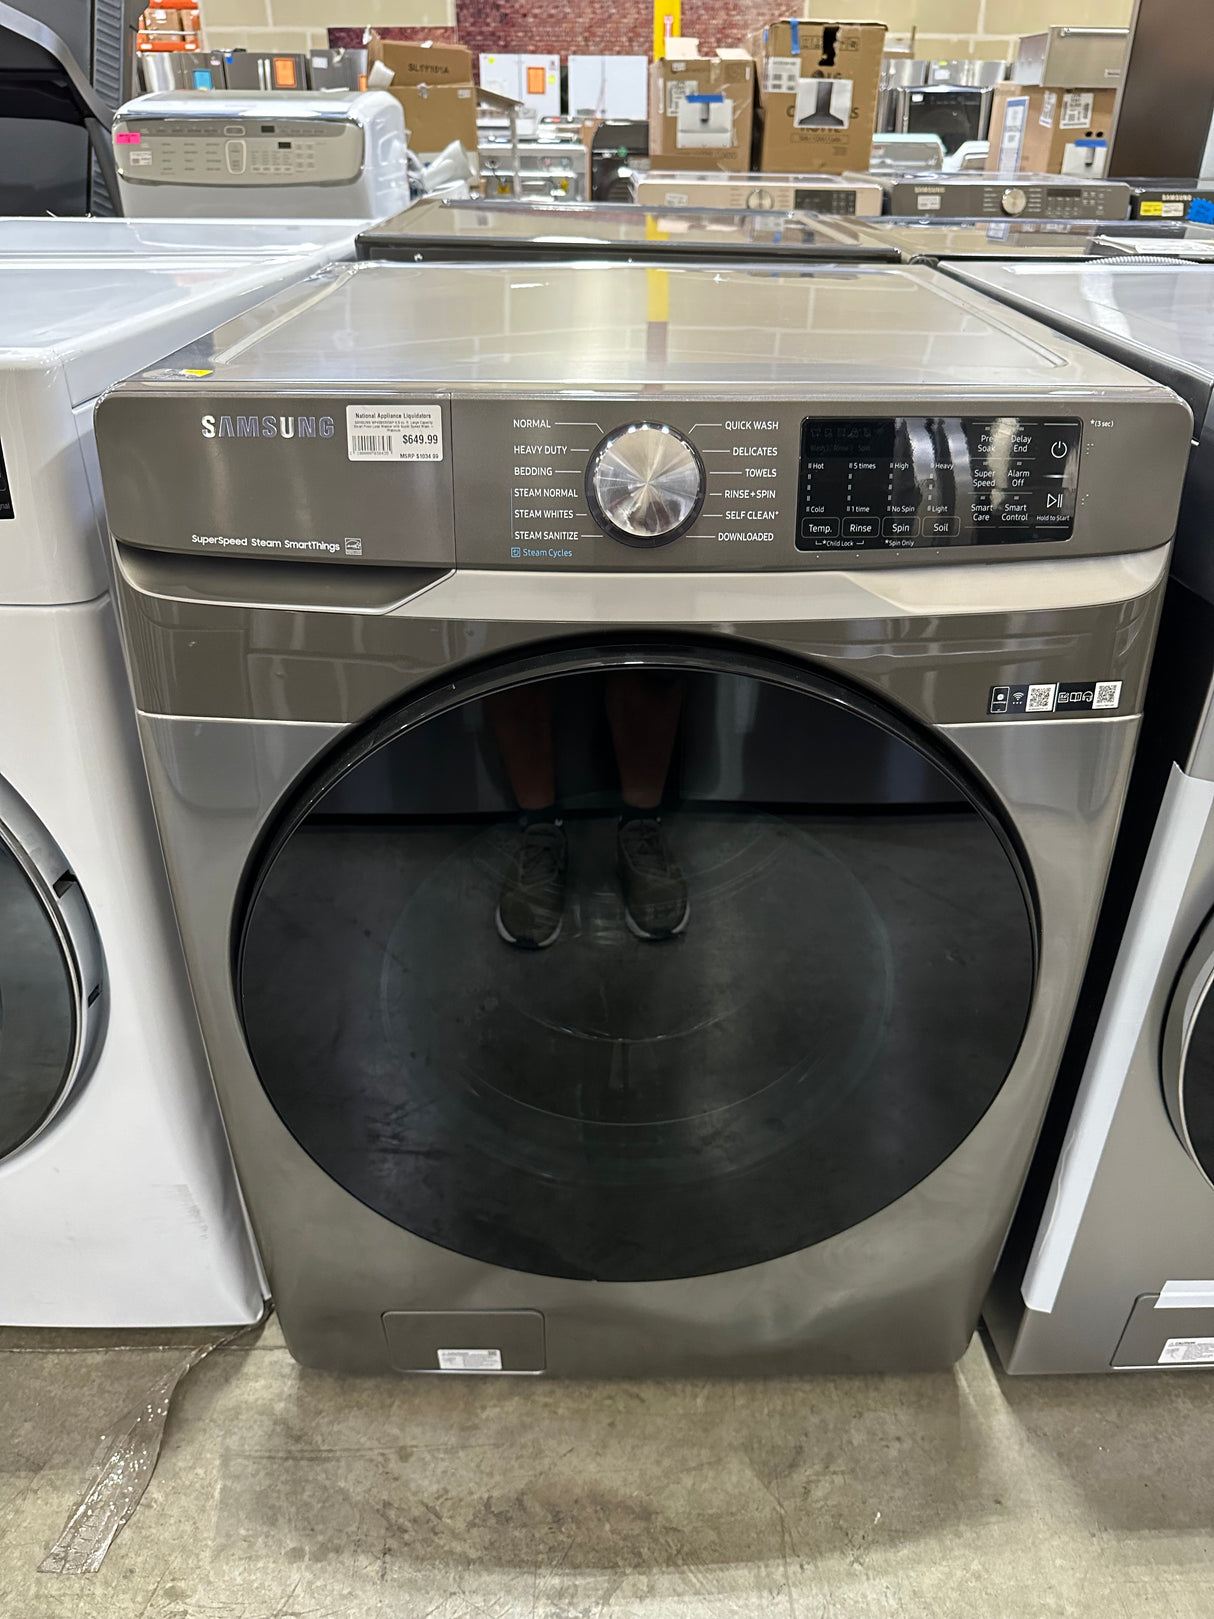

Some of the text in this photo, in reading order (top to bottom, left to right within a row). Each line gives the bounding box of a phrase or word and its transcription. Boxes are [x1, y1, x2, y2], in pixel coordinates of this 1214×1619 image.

[201, 415, 335, 438] SAMSUNG
[513, 420, 551, 428] NORMAL
[724, 421, 779, 430] QUICK WASH
[402, 434, 438, 444] $649.99
[981, 434, 994, 442] Pre
[1011, 434, 1032, 443] Delay
[514, 446, 568, 454] HEAVY DUTY
[732, 447, 778, 456] DELICATES
[978, 444, 996, 452] Soak
[1014, 444, 1028, 452] End
[514, 467, 552, 476] BEDDING
[745, 468, 777, 477] TOWELS
[974, 470, 996, 478] Super
[973, 479, 996, 488] Speed
[1012, 479, 1024, 487] Off
[514, 488, 578, 497] STEAM NORMAL
[724, 490, 776, 498] RINSE+SPIN
[971, 504, 993, 512] Smart
[1004, 504, 1027, 512] Smart
[514, 510, 574, 518] STEAM WHITES
[725, 511, 746, 519] SELF
[973, 513, 990, 521] Care
[1001, 513, 1028, 521] Control
[809, 524, 832, 533] Temp.
[850, 524, 872, 532] Rinse
[892, 524, 910, 533] Spin
[933, 523, 949, 532] Soil
[514, 532, 578, 540] STEAM SANITIZE
[718, 532, 774, 541] DOWNLOADED
[192, 535, 247, 547] SuperSpeed
[251, 538, 282, 548] Steam
[284, 540, 340, 553] SmartThings
[522, 548, 573, 558] Steam Cycles
